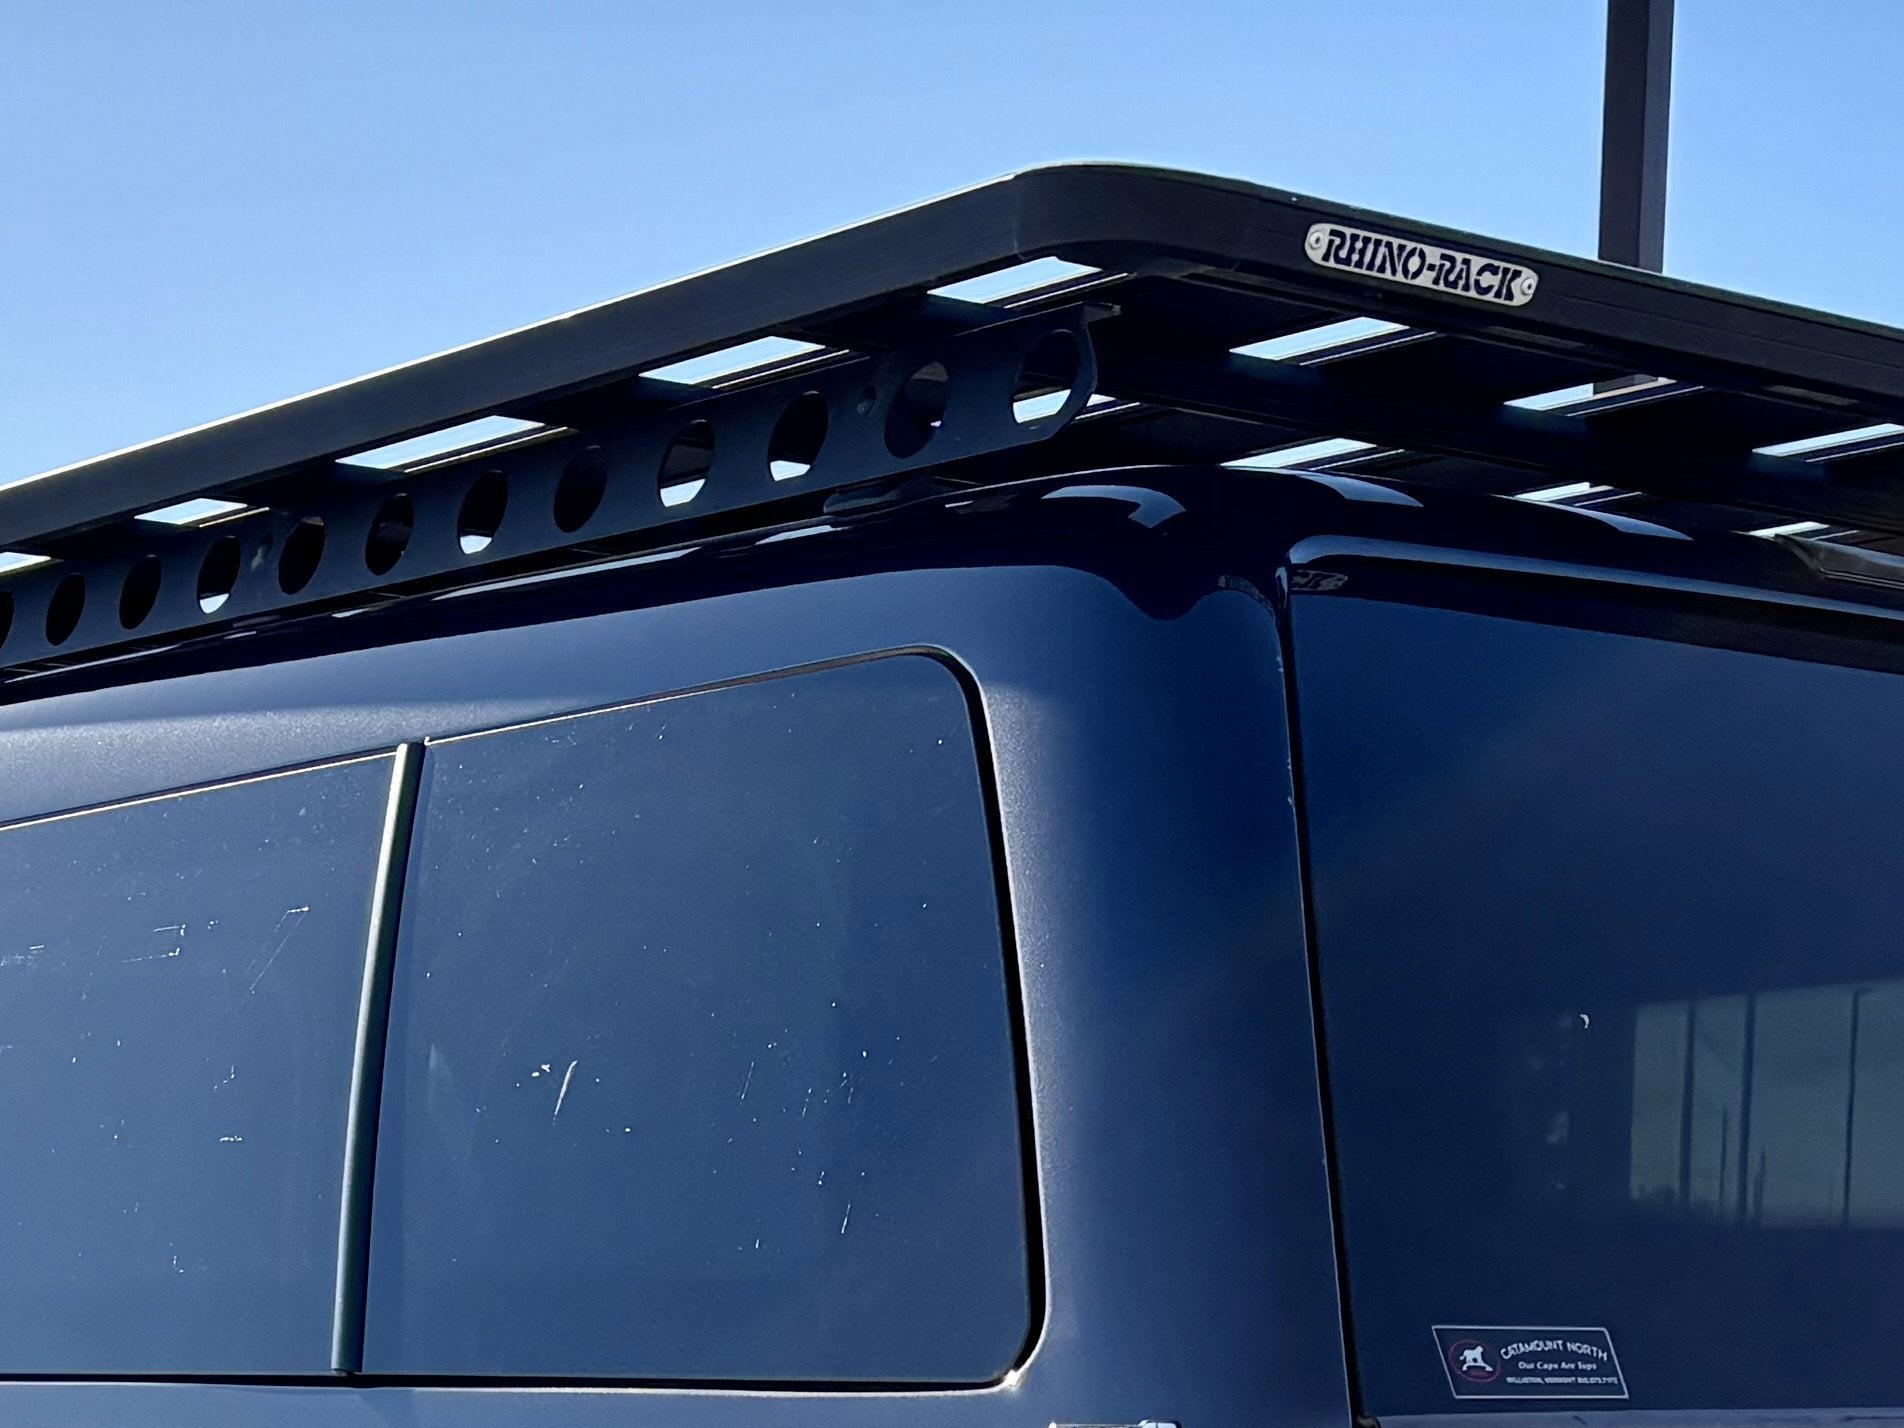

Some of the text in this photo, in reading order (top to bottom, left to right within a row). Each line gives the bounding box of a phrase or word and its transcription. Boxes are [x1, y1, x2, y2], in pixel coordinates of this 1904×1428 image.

[1322, 228, 1523, 302] RHINO-RACK
[1500, 1339, 1608, 1362] CATAMOUNT NORTH
